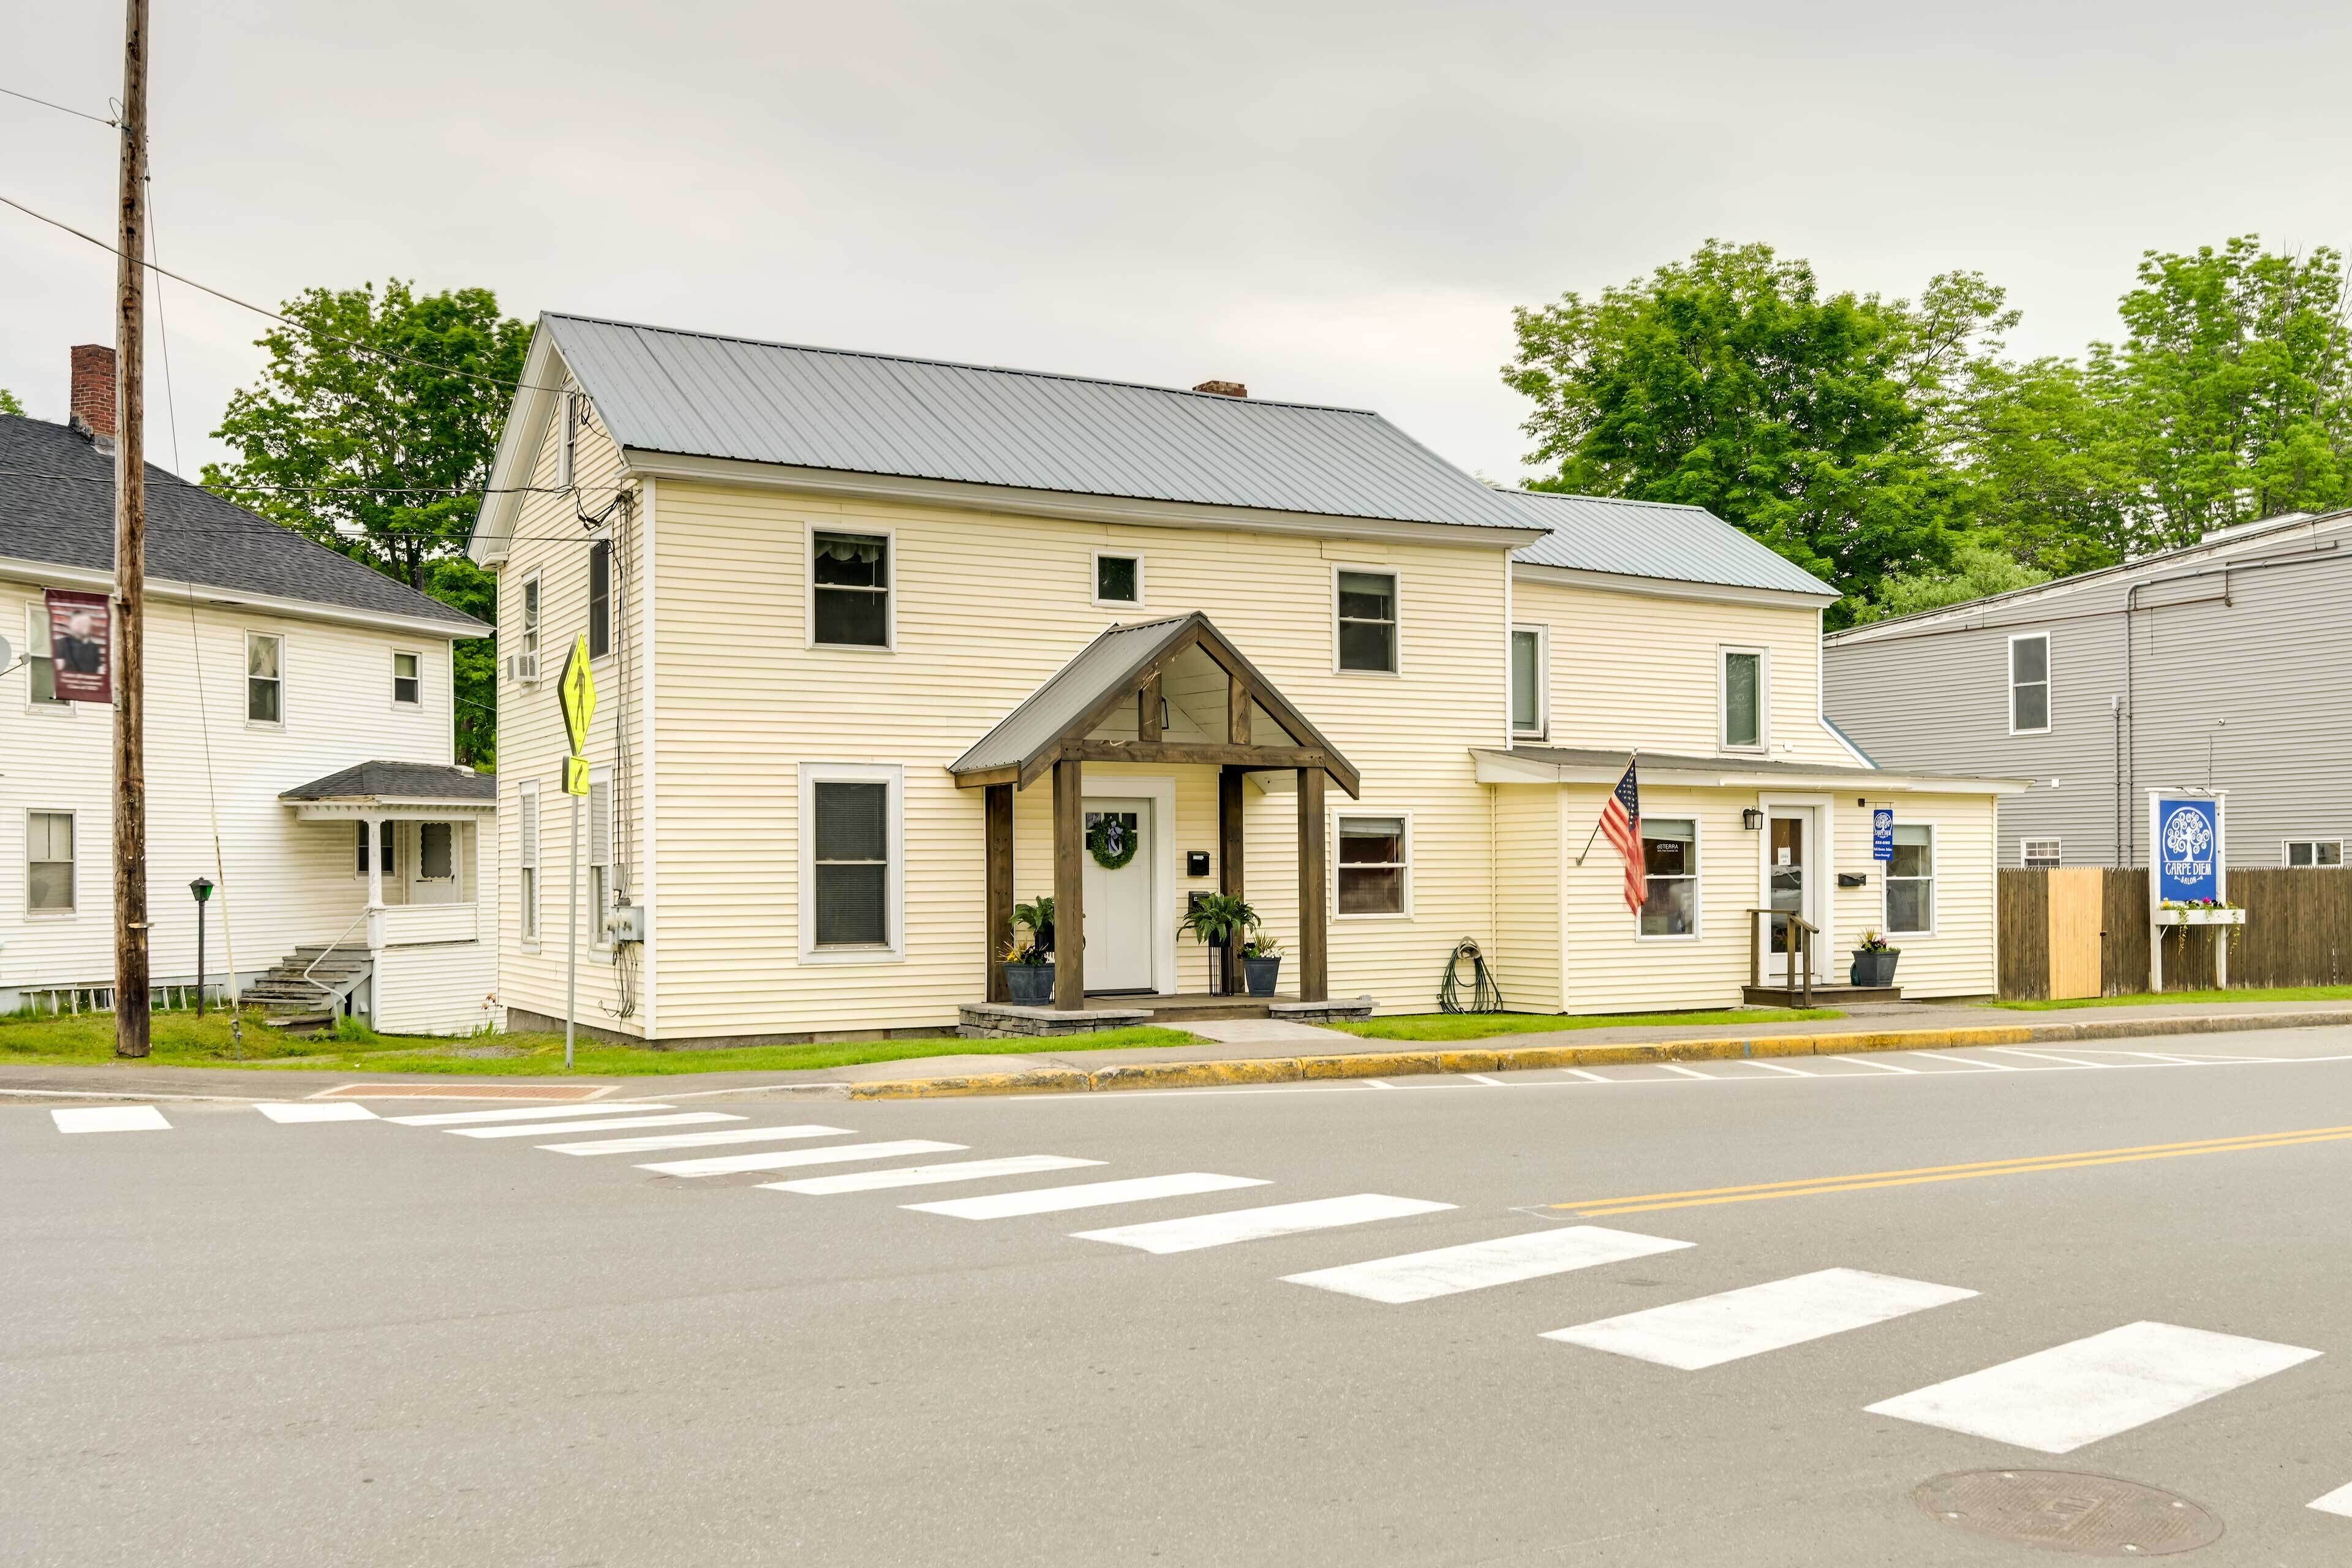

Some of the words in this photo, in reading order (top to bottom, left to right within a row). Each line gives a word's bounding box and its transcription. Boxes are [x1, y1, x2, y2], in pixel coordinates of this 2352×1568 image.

[2165, 862, 2192, 875] CARPE
[2193, 862, 2212, 875] DIEM
[2180, 876, 2197, 885] SALON
